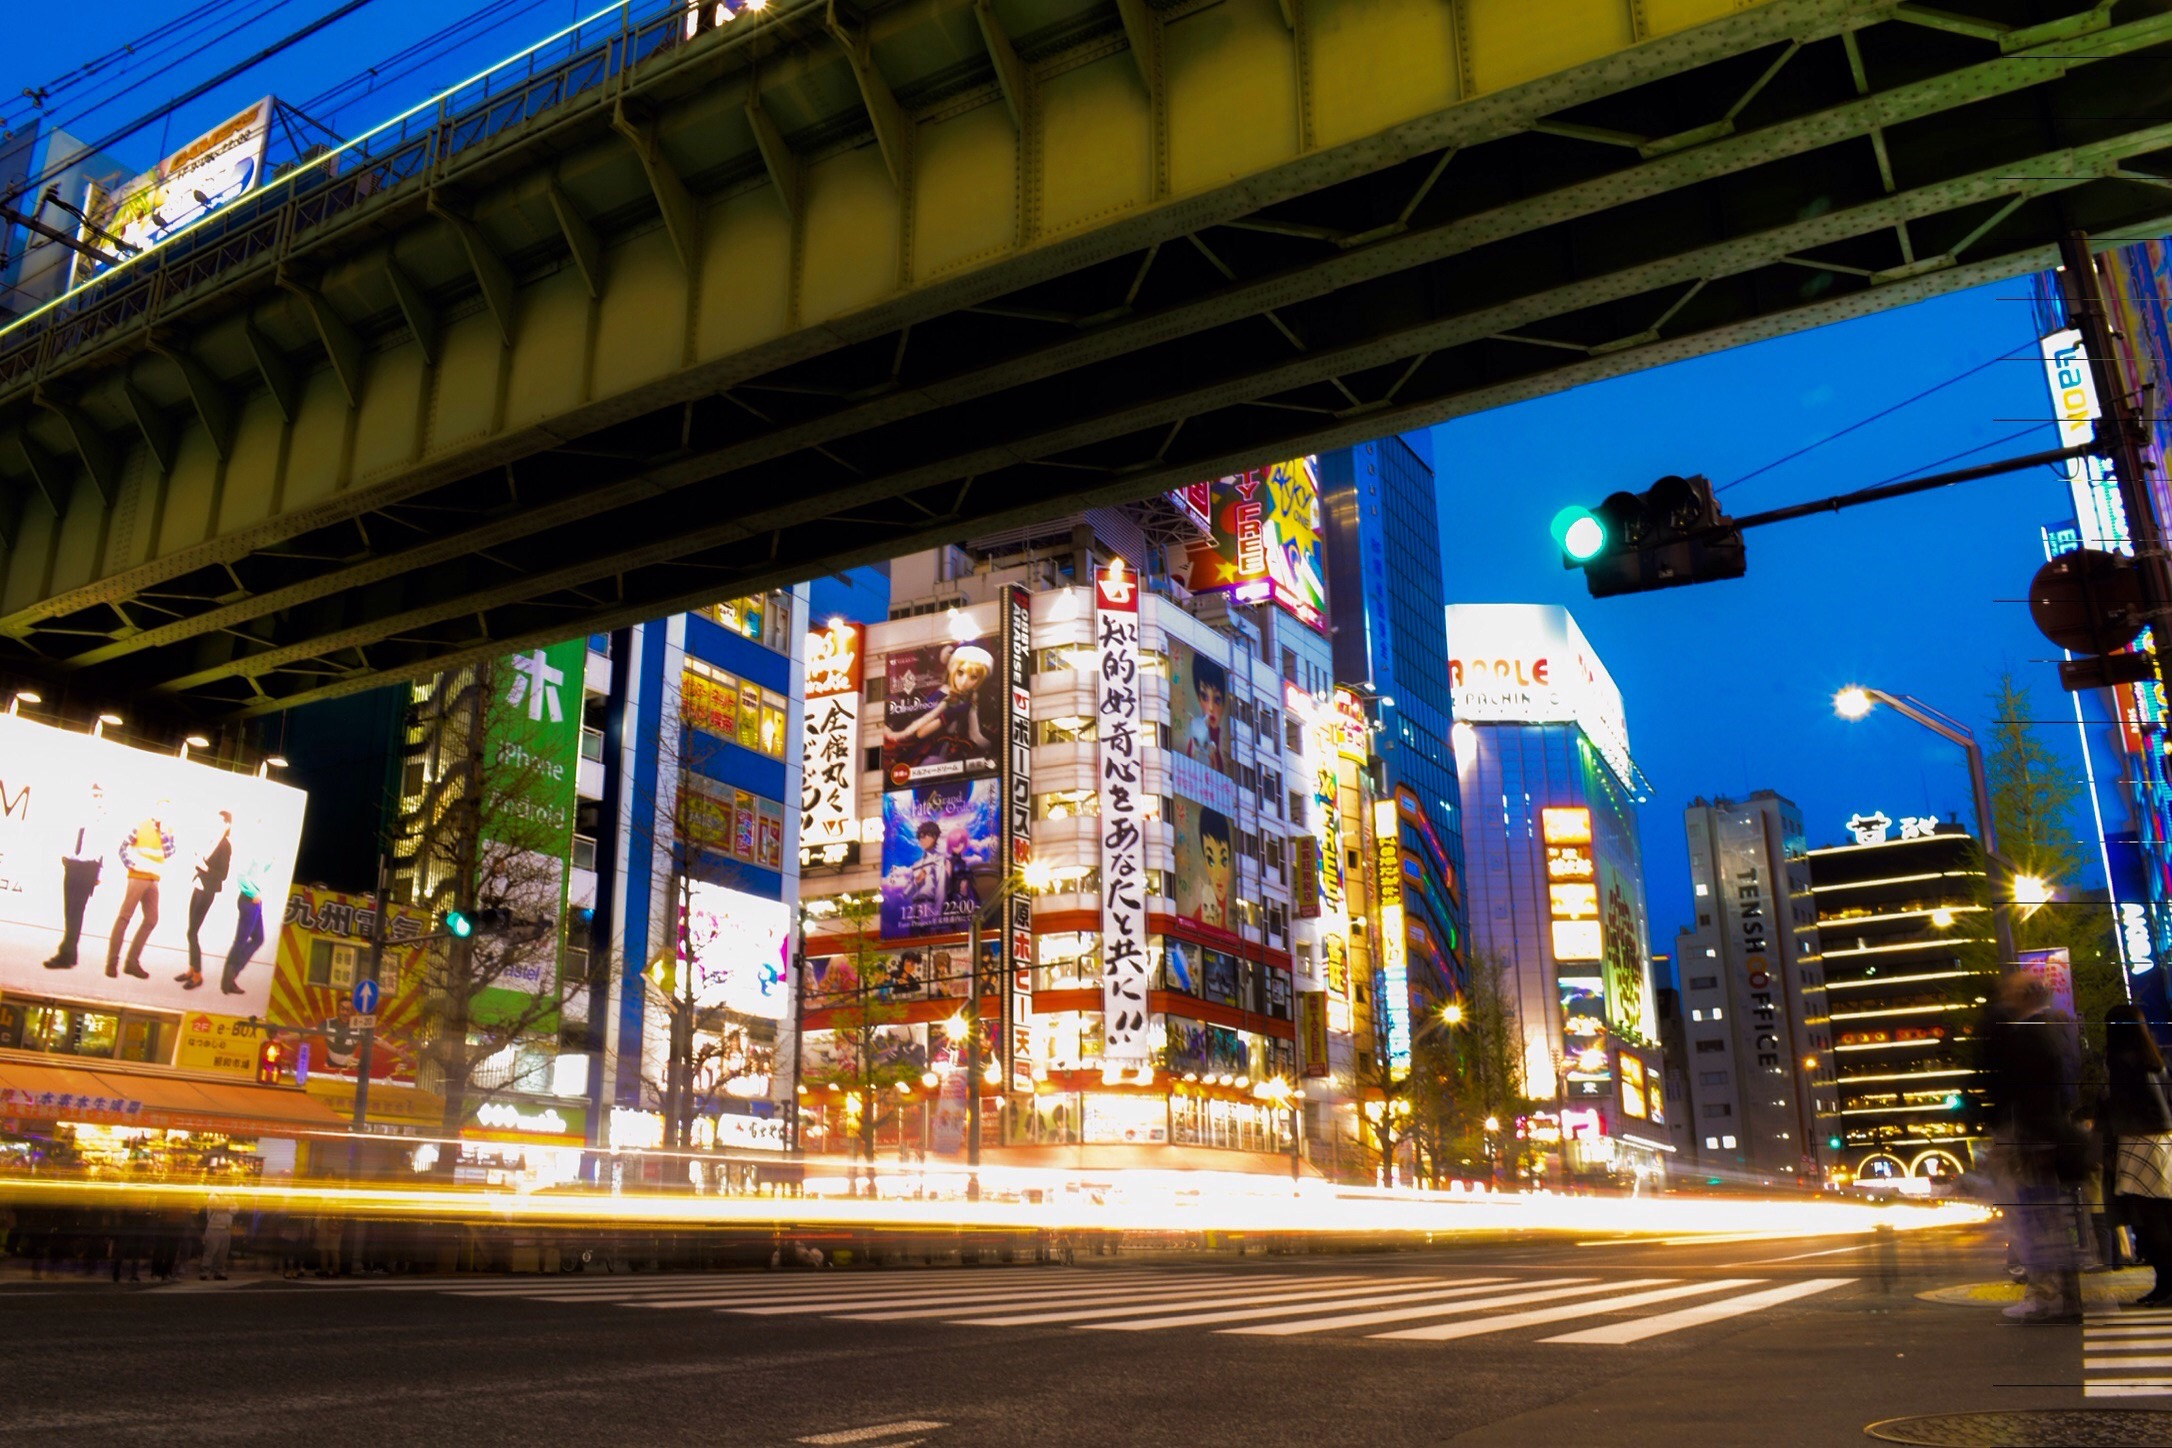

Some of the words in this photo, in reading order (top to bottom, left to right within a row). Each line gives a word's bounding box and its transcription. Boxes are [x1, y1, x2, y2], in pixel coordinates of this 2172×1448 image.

[1236, 502, 1265, 576] FREE
[1464, 692, 1561, 706] PACHINO
[499, 738, 565, 782] iPhone
[1012, 716, 1032, 1088] ボークス秋原ホビー天国
[497, 961, 542, 983] astel
[216, 1020, 258, 1039] e-BOX
[1748, 971, 1779, 1068] OFFICE
